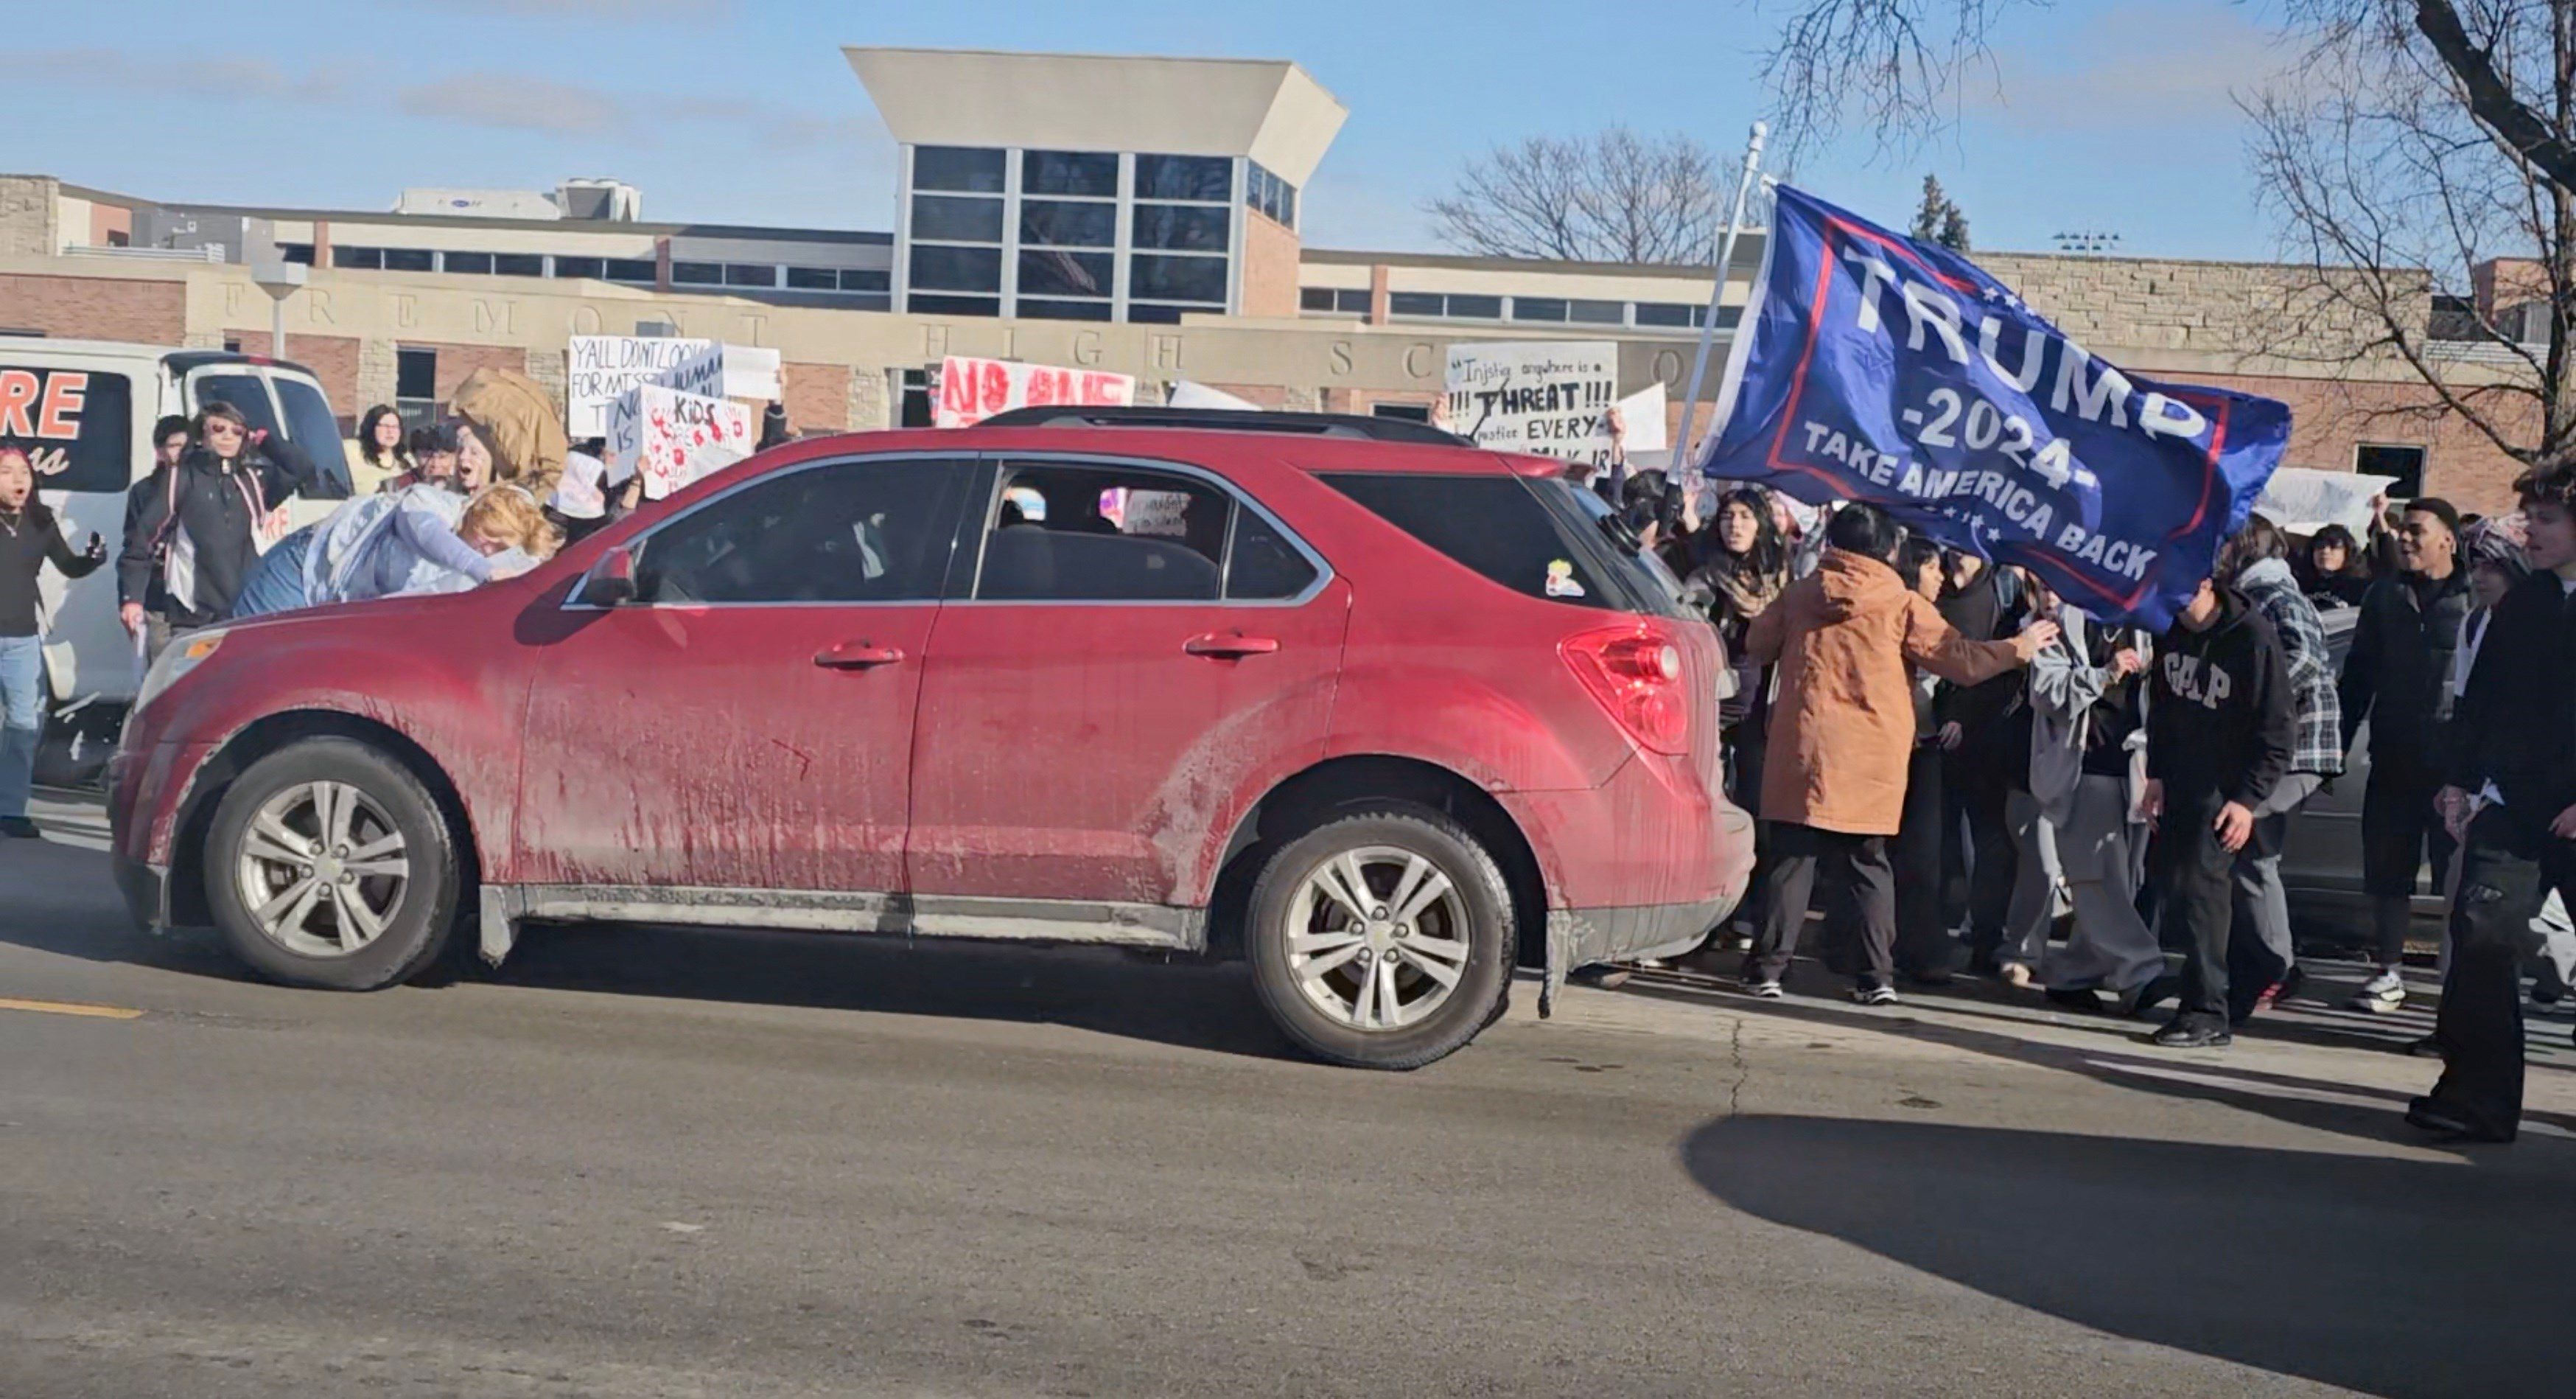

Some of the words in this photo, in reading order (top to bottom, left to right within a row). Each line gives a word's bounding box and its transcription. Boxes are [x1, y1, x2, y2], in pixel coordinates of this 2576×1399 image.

[920, 323, 1183, 369] HIGH
[1843, 245, 2208, 441] TRUMP
[572, 372, 603, 399] FOR
[942, 358, 1010, 413] NO
[1803, 420, 1900, 488] TAKE
[1896, 462, 2054, 540] AMERICA
[2057, 522, 2158, 581] BACK
[2163, 651, 2231, 709] GAP
